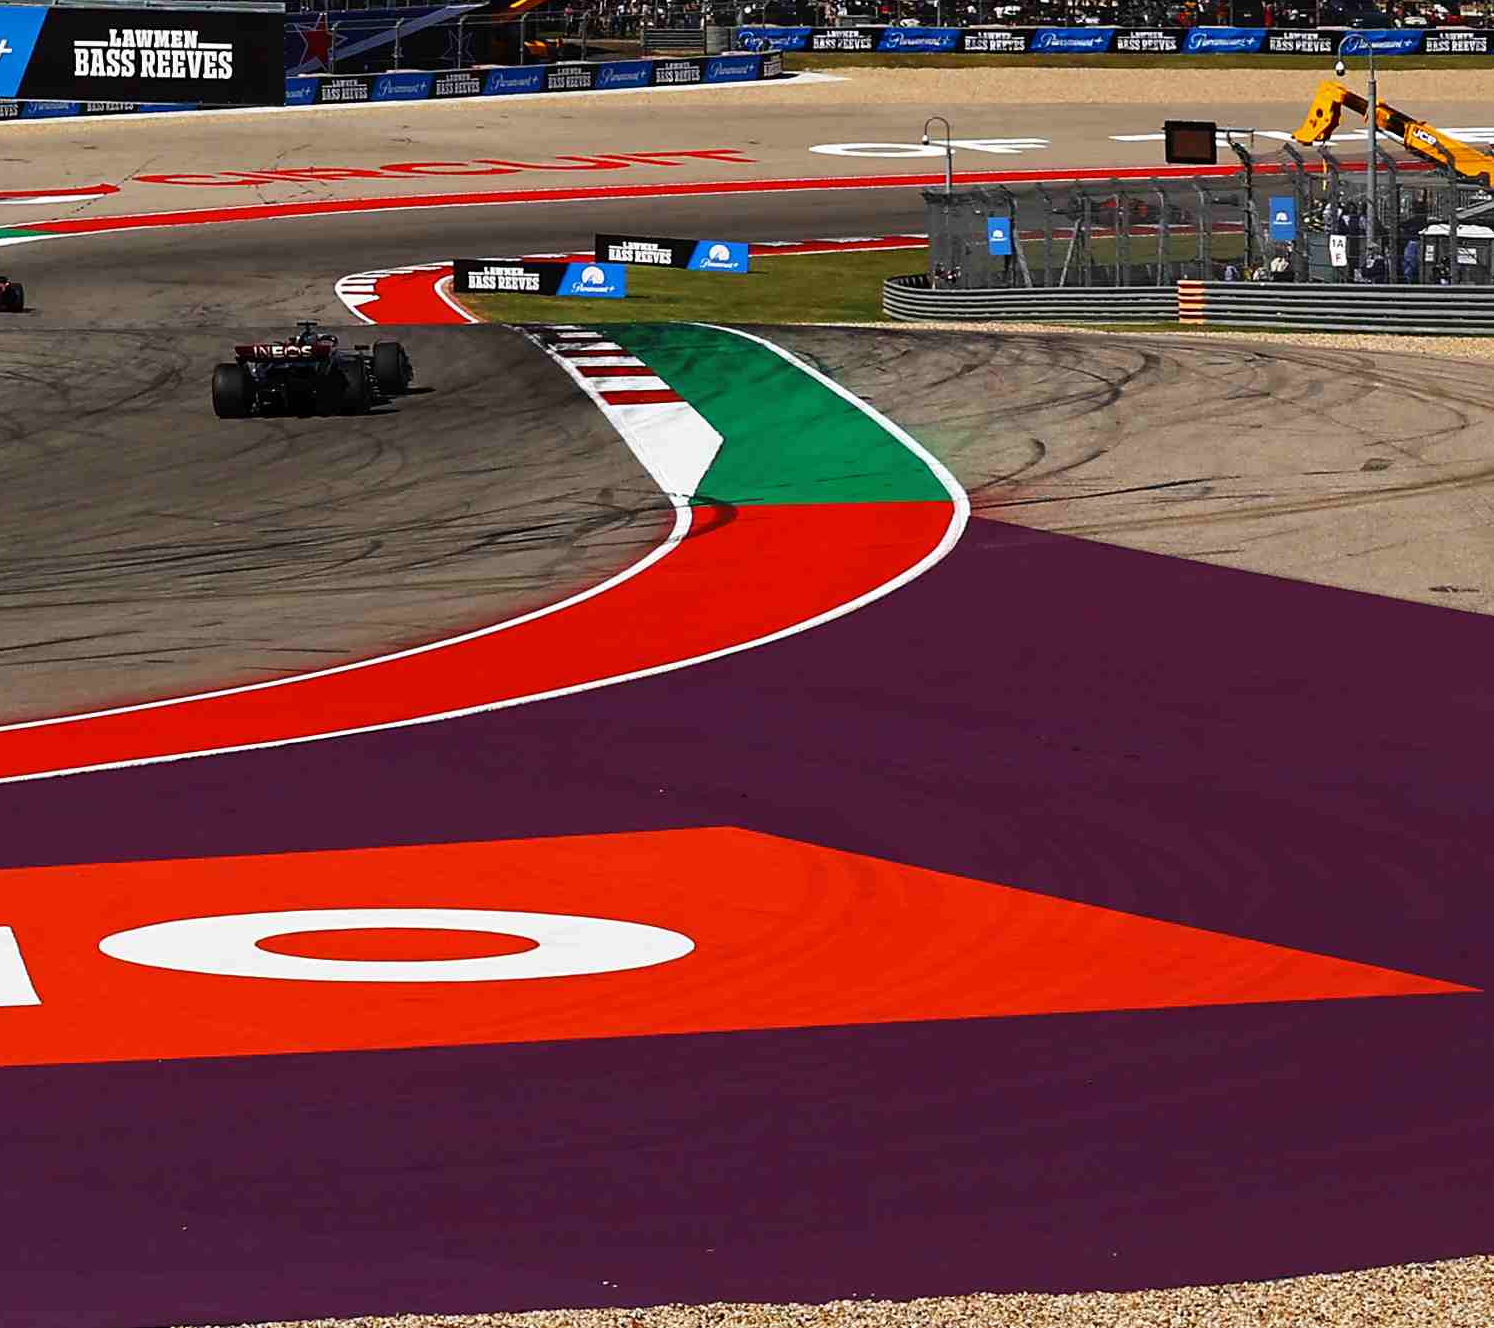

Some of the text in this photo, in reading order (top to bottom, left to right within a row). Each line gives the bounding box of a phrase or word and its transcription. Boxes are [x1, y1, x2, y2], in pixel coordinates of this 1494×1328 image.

[109, 30, 197, 48] LAWMEN
[74, 49, 232, 79] BASS REEVES
[132, 149, 756, 186] CIRCUIT
[623, 241, 658, 250] LAWMEN
[609, 249, 672, 265] BASS REEVES
[484, 267, 523, 276] LAWMEN
[468, 275, 539, 291] BASS REEVES
[254, 345, 312, 358] INEOS
